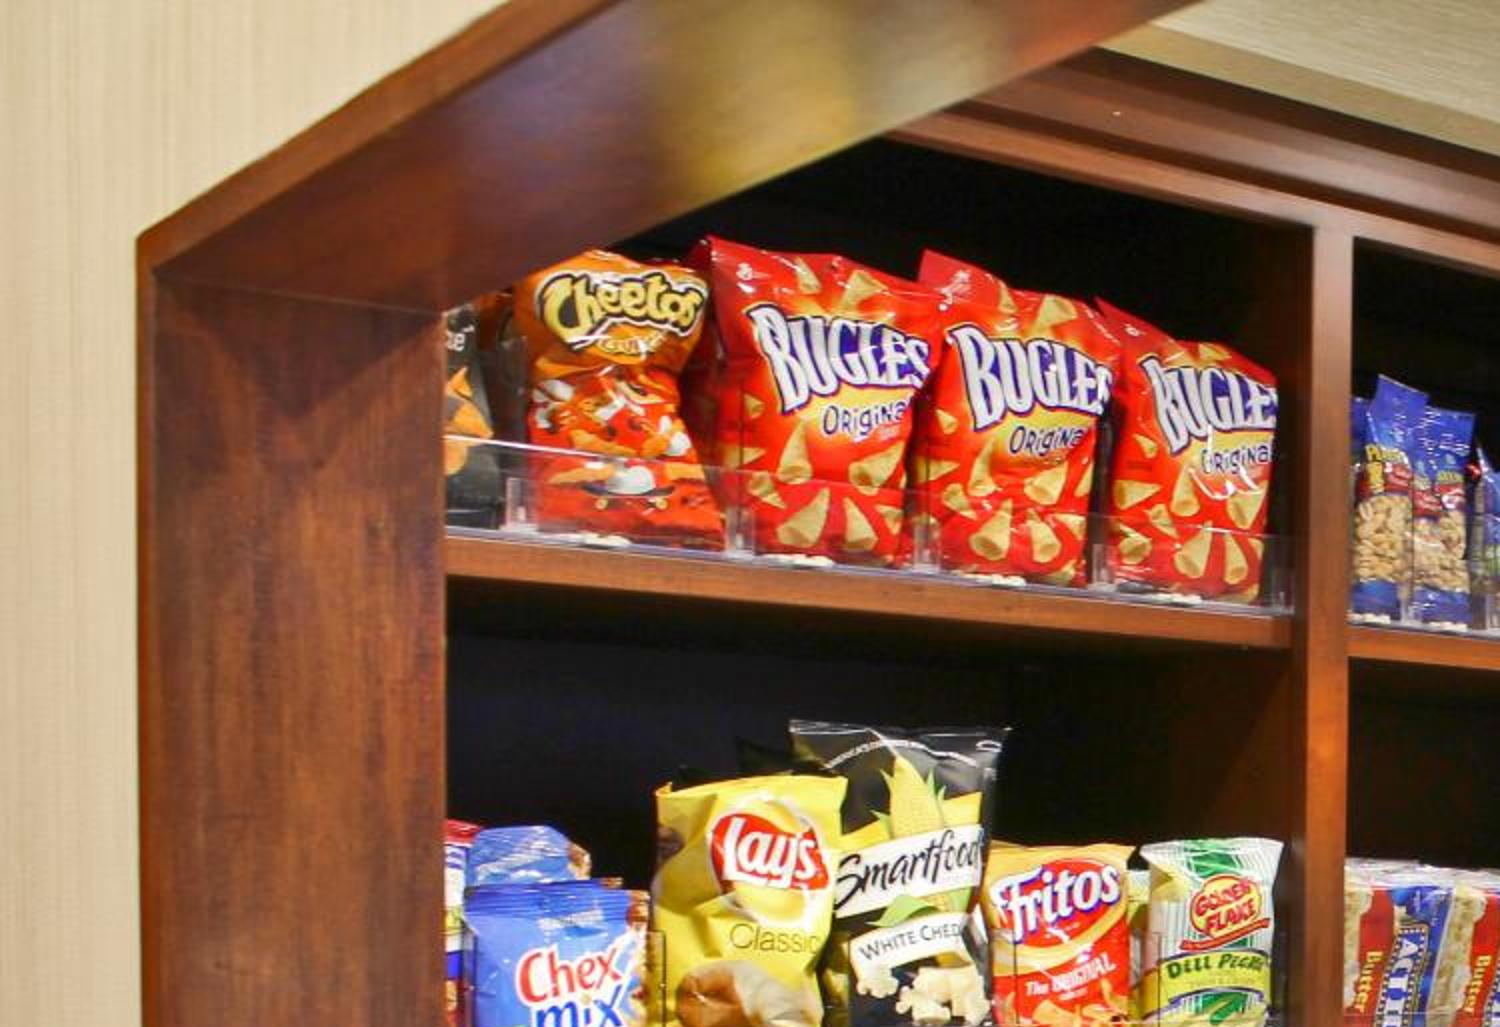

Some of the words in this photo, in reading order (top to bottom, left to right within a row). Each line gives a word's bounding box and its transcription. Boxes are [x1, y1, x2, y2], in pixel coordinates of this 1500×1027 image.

[543, 270, 709, 348] Cheetos
[744, 303, 931, 414] BUGLES
[822, 400, 907, 436] Origina
[1139, 355, 1279, 456] BUGLE
[1009, 425, 1086, 455] Origina
[990, 864, 1121, 943] Fritos
[729, 923, 821, 953] Classic
[859, 931, 917, 960] WHITE
[920, 923, 961, 941] CHED
[518, 948, 621, 1003] Chex
